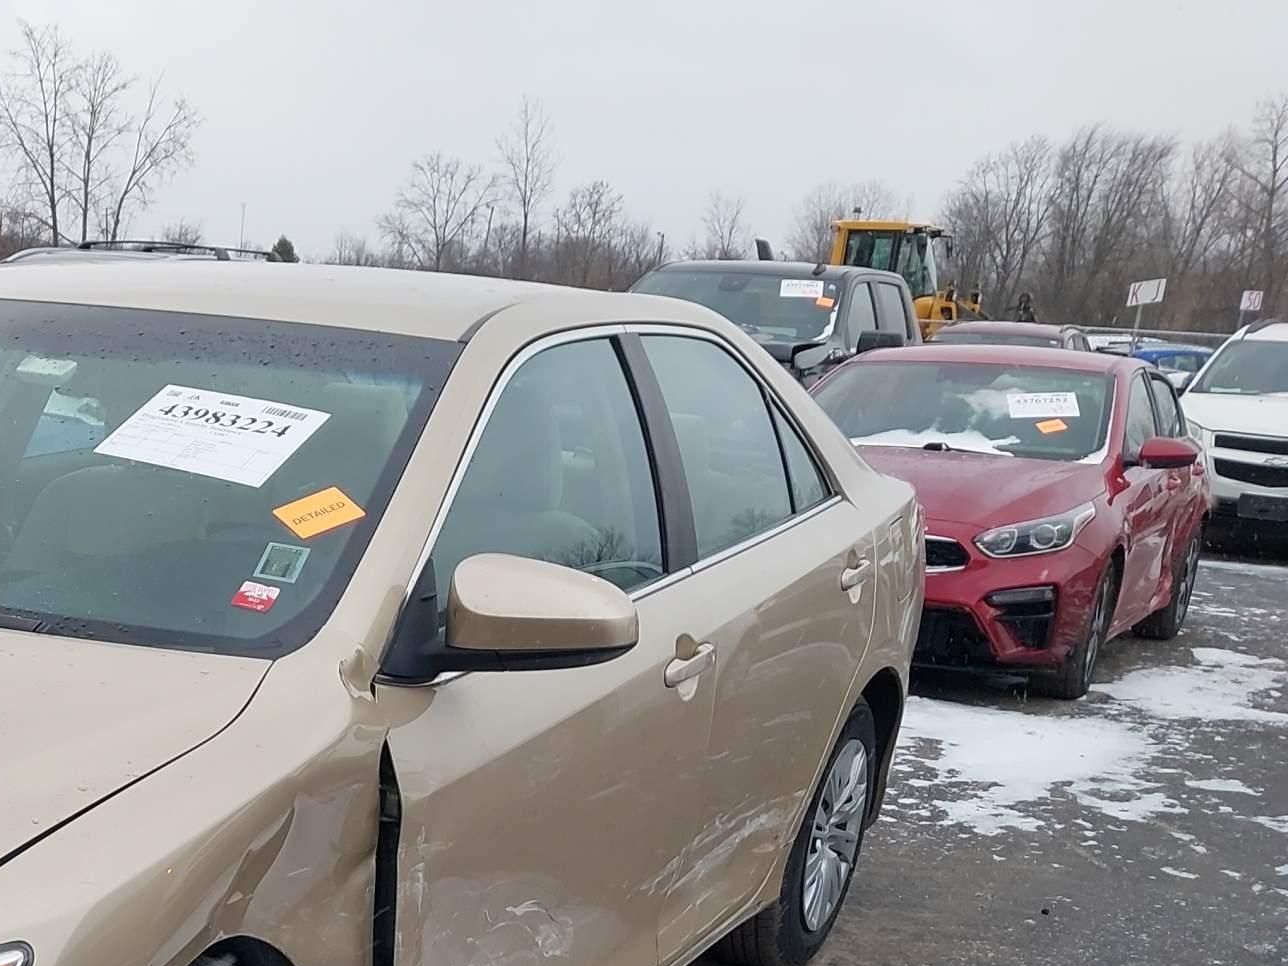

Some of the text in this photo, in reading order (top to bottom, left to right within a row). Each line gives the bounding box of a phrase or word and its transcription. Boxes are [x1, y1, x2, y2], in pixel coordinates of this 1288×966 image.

[1129, 279, 1162, 305] K J
[1247, 290, 1261, 308] 50
[158, 402, 292, 438] 43983224
[292, 501, 345, 526] DETAILED
